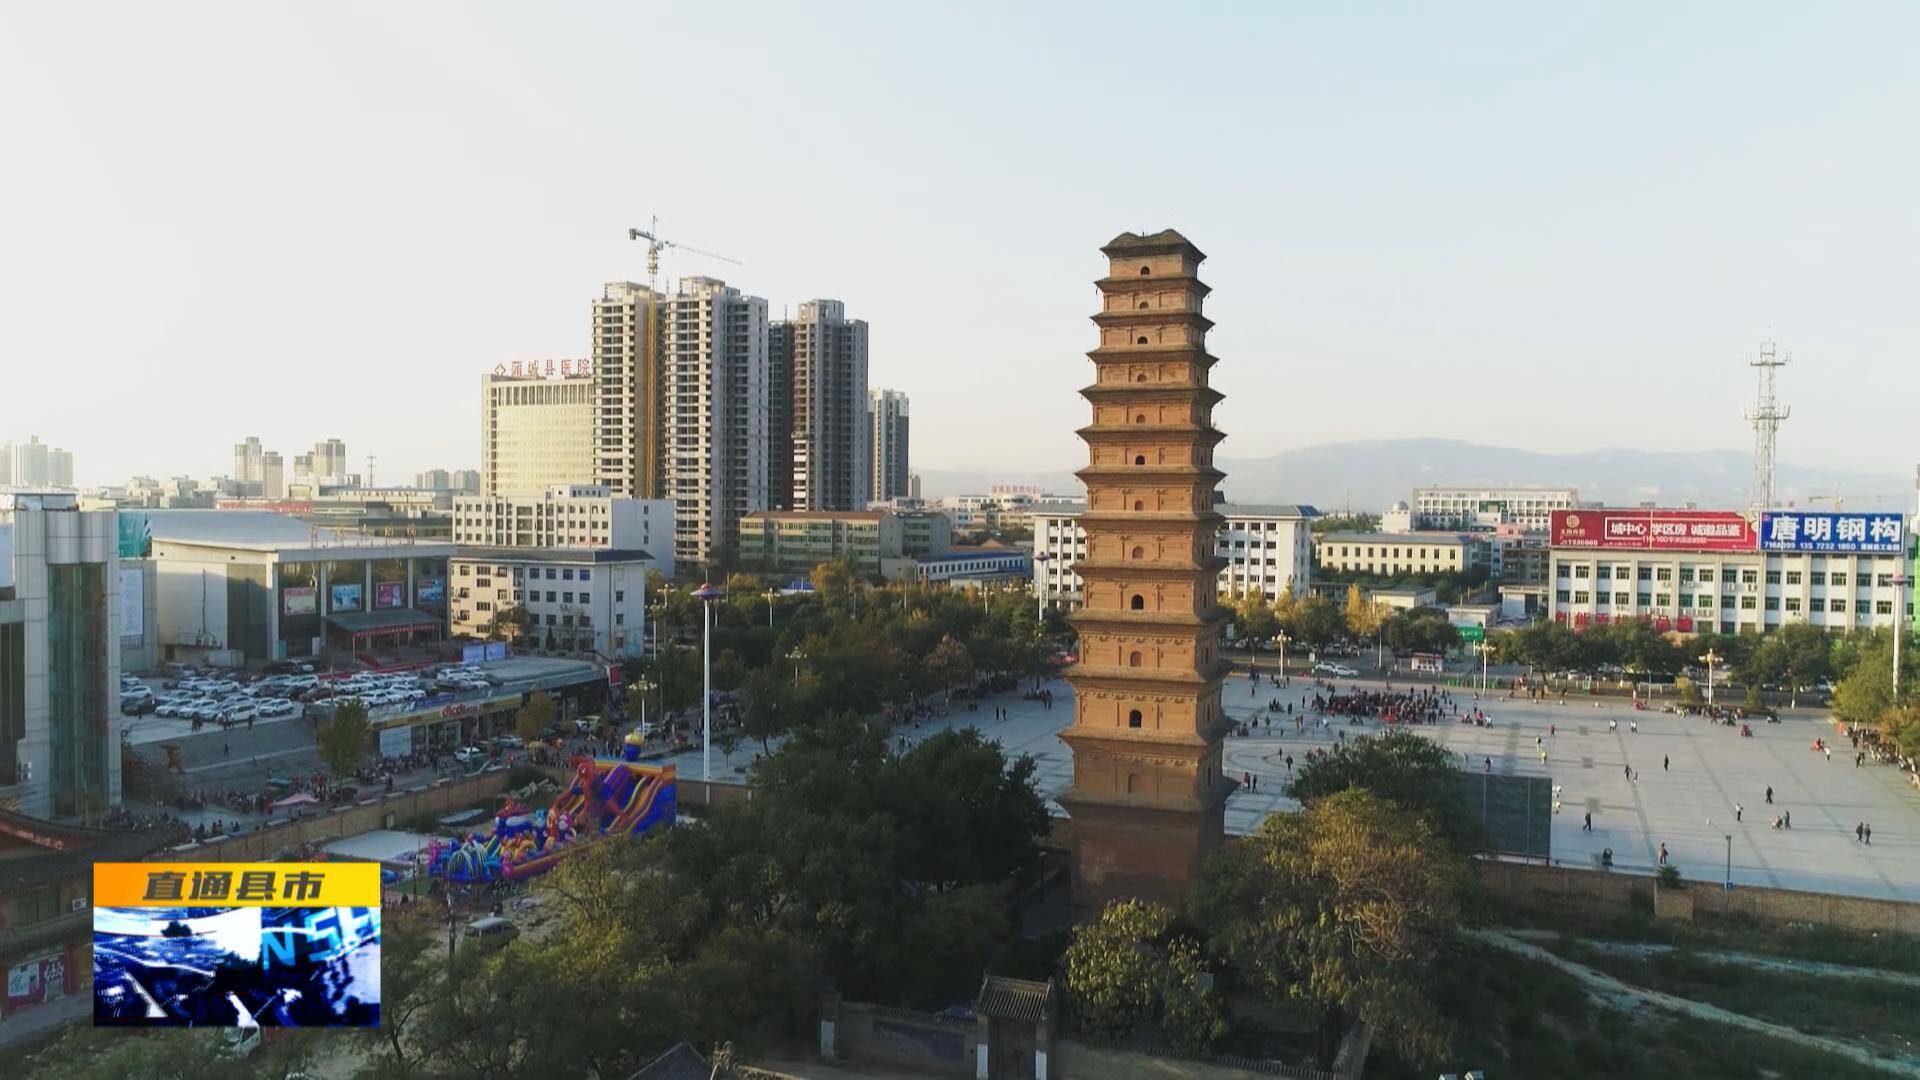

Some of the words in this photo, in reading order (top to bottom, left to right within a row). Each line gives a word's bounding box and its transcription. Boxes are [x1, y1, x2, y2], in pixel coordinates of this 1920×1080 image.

[1611, 522, 1647, 535] 城中心
[1652, 523, 1687, 536] 学区房
[1770, 516, 1901, 542] 唐明钢构
